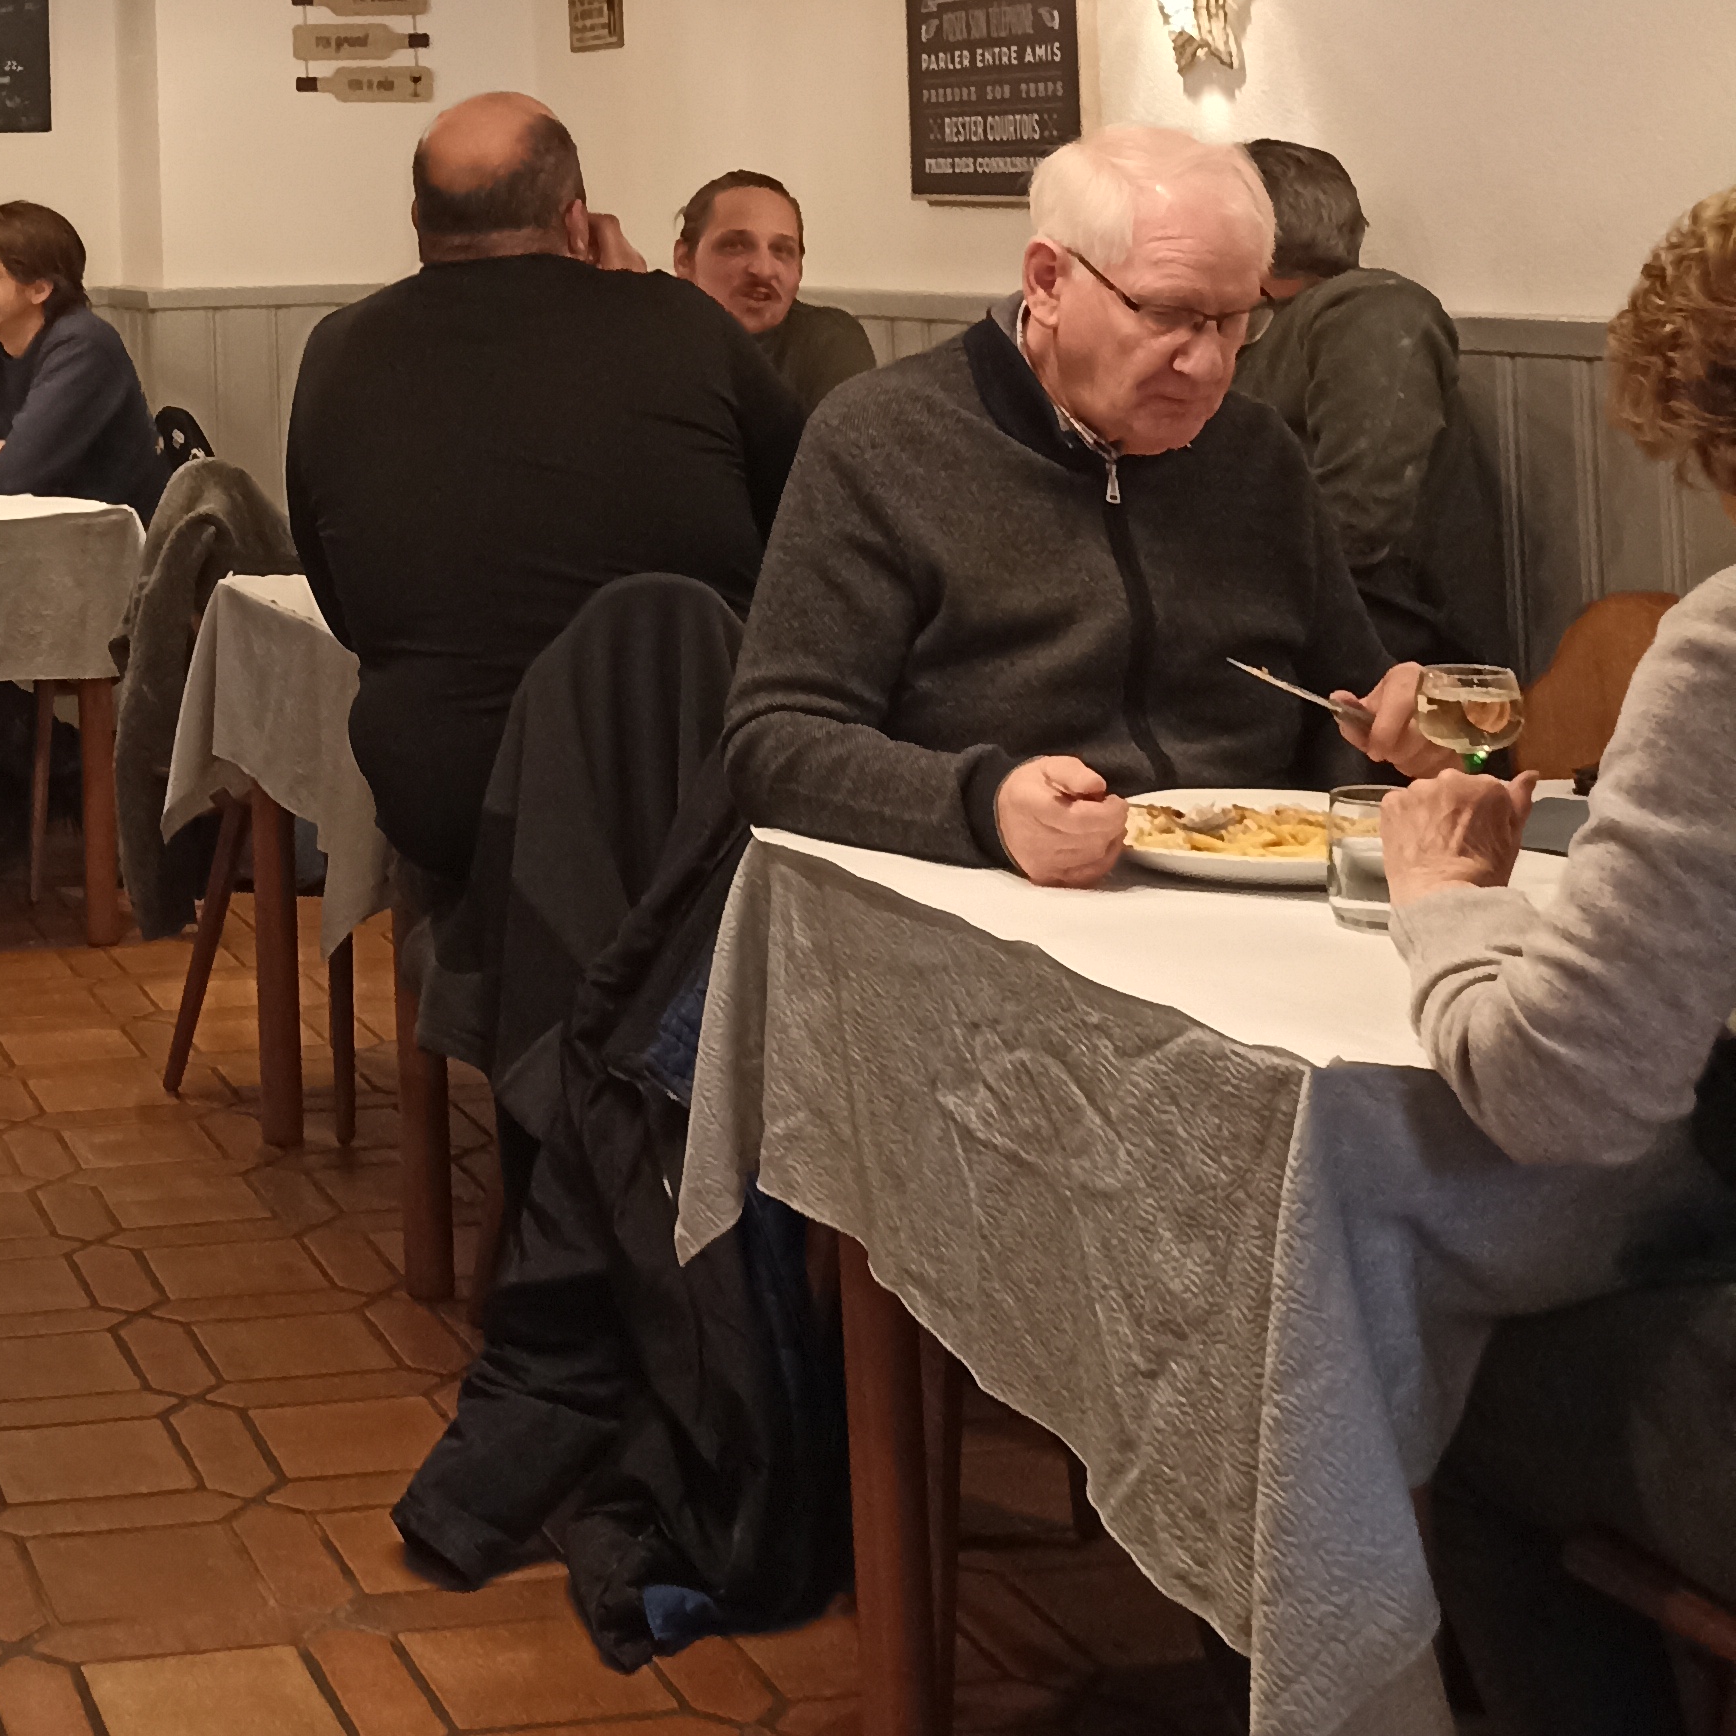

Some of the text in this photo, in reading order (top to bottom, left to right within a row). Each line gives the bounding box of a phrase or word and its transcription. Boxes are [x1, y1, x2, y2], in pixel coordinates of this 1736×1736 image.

[921, 41, 1062, 72] PARLER ENTRE AMIS
[1020, 80, 1063, 99] TEMPS
[944, 113, 1041, 143] RESTER COURTOIS
